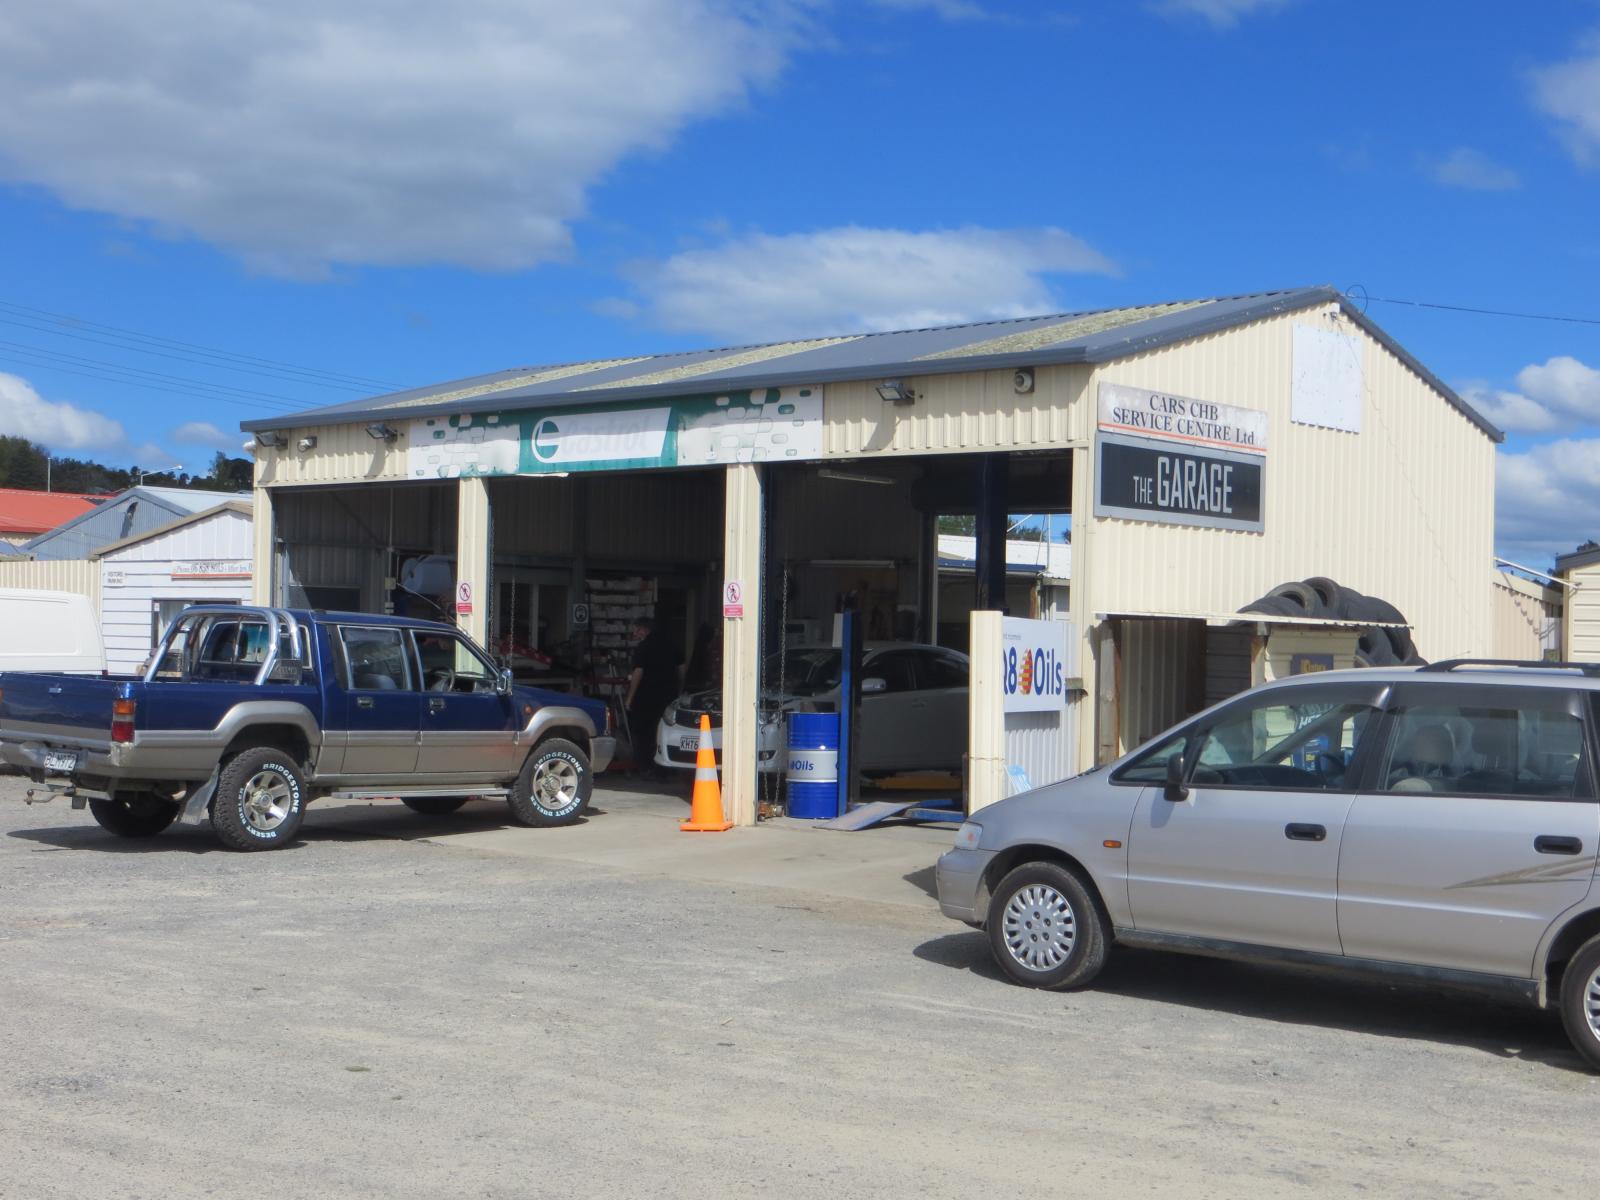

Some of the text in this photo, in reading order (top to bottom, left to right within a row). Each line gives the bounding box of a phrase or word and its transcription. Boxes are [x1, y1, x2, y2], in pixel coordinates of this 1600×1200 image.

[1113, 407, 1255, 445] SERVICE CENTRE Ltd
[1149, 395, 1218, 420] CARS CHB
[1133, 456, 1233, 514] THE GARAGE
[1033, 647, 1062, 696] Oils
[534, 751, 583, 773] BRIDGESTONE
[262, 763, 300, 813] BRIDGESTONE
[246, 825, 277, 838] DESERT
